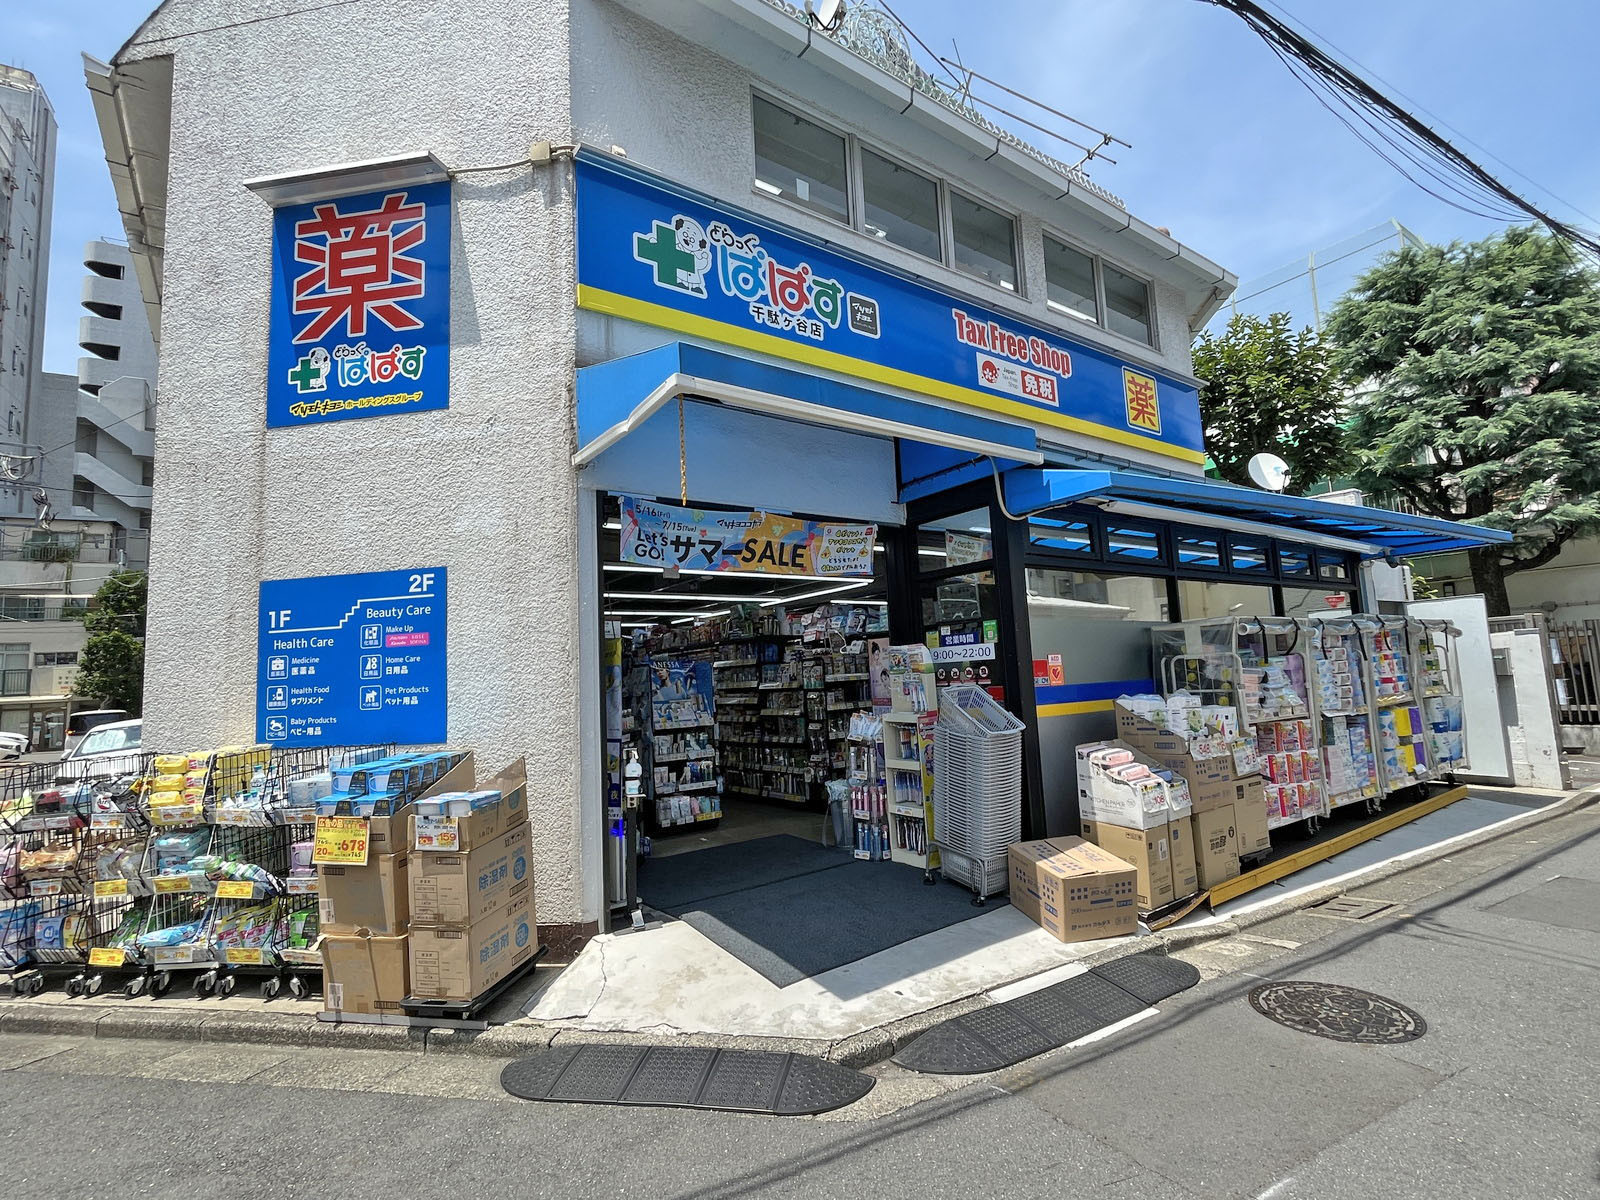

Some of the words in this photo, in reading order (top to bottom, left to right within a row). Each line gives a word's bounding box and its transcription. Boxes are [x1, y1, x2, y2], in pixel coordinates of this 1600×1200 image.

[293, 192, 425, 344] 薬
[721, 244, 842, 326] ぱぱす
[954, 311, 988, 347] Tax
[989, 323, 1028, 361] Free
[1029, 337, 1072, 377] Shop
[339, 346, 426, 386] ぱぱす
[1024, 374, 1054, 400] 免税
[1128, 375, 1157, 428] 薬
[636, 529, 669, 547] Let's
[634, 543, 665, 561] GO!
[408, 573, 435, 593] 2F
[366, 606, 403, 620] Beauty
[406, 604, 432, 616] Care
[268, 609, 292, 629] 1F
[385, 625, 404, 633] Make
[404, 624, 414, 634] Up
[273, 638, 309, 651] Health
[310, 636, 335, 650] Care
[944, 634, 975, 645] 営業時間
[291, 656, 320, 664] Medicine
[385, 656, 403, 664] Home
[404, 655, 421, 663] Care
[291, 666, 316, 676] 医薬品
[385, 665, 409, 675] 日用品
[291, 686, 313, 695] Health
[313, 686, 330, 694] Food
[385, 687, 398, 695] Pet
[398, 686, 429, 694] Products
[290, 696, 324, 706] サプリメント
[384, 695, 419, 706] ペット用品
[290, 717, 307, 726] Baby
[307, 716, 337, 725] Products
[290, 726, 322, 736] ベビー用品
[316, 847, 328, 856] 20
[341, 840, 366, 852] 678
[479, 864, 508, 891] 除湿剤
[479, 932, 509, 964] 除湿剤
